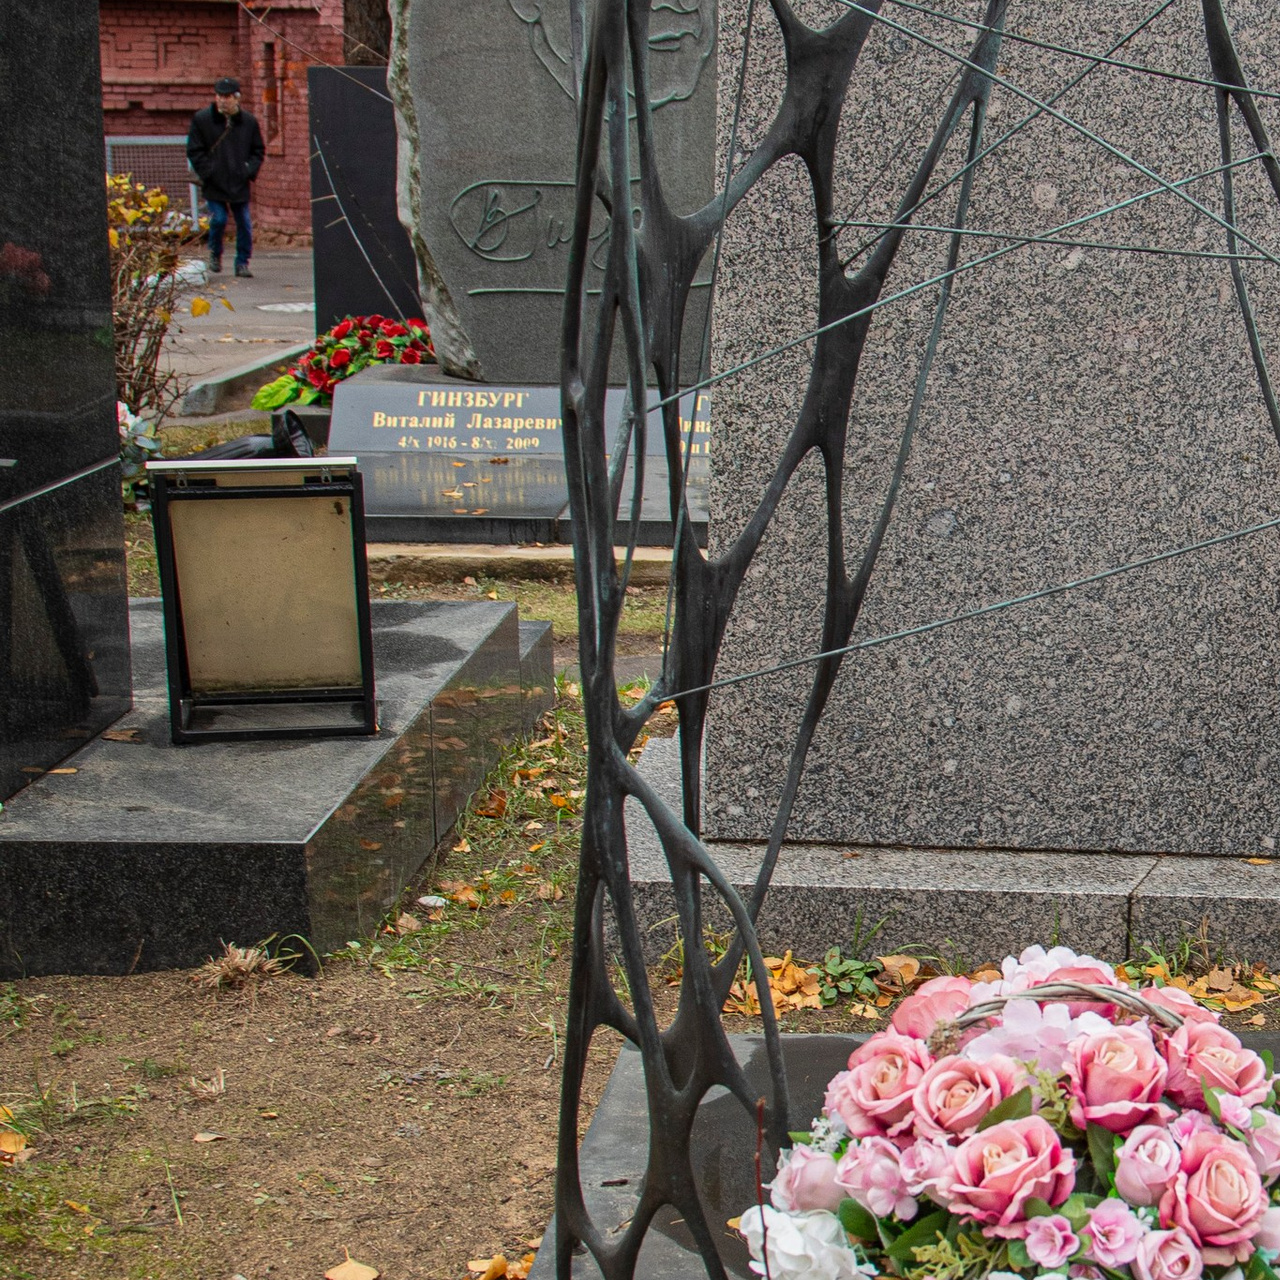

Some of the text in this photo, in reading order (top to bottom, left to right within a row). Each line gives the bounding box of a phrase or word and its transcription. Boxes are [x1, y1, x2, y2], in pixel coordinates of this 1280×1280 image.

[417, 391, 530, 408] ГИНЗБУРГ
[372, 411, 456, 428] Виталий
[427, 435, 457, 449] 1916
[505, 436, 540, 451] 2009
